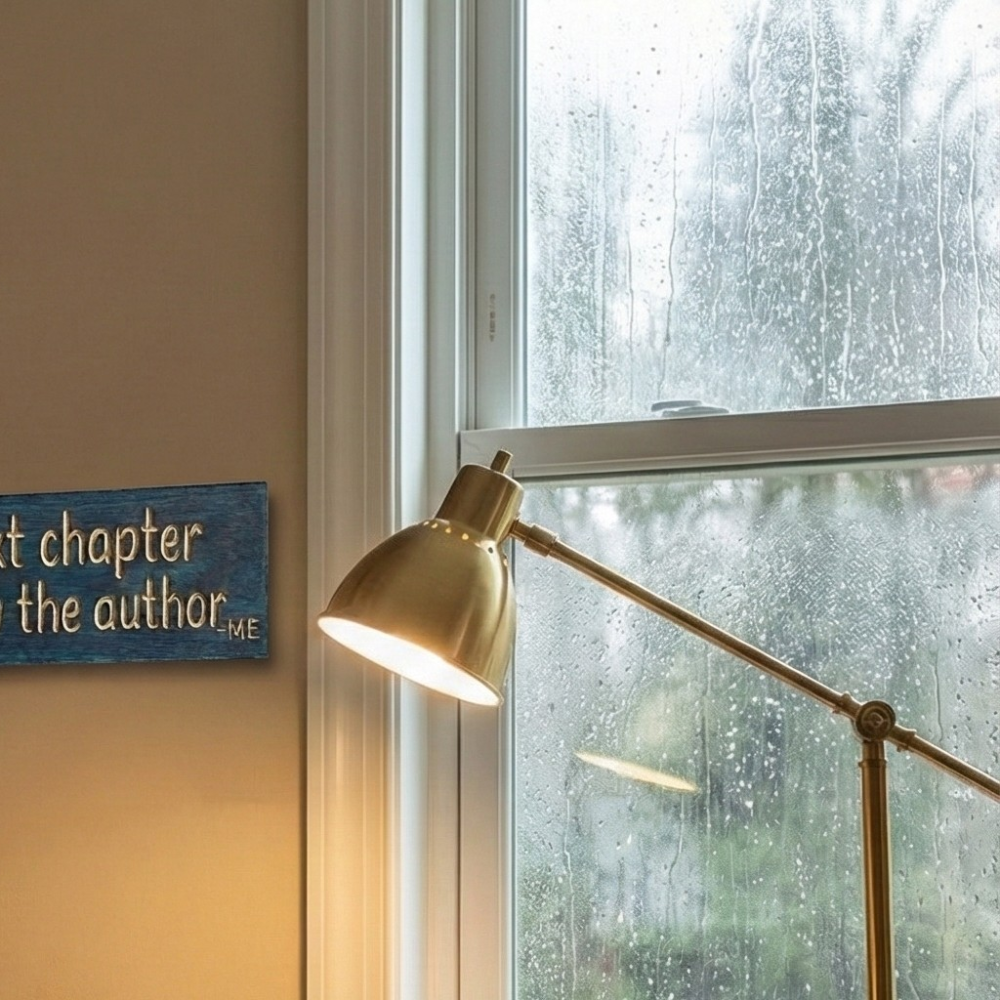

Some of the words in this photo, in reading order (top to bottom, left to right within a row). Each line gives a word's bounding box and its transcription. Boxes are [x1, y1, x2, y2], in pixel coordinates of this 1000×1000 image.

[40, 507, 203, 580] chapter
[16, 580, 81, 634] the
[93, 574, 227, 631] author
[216, 617, 260, 640] -ME
